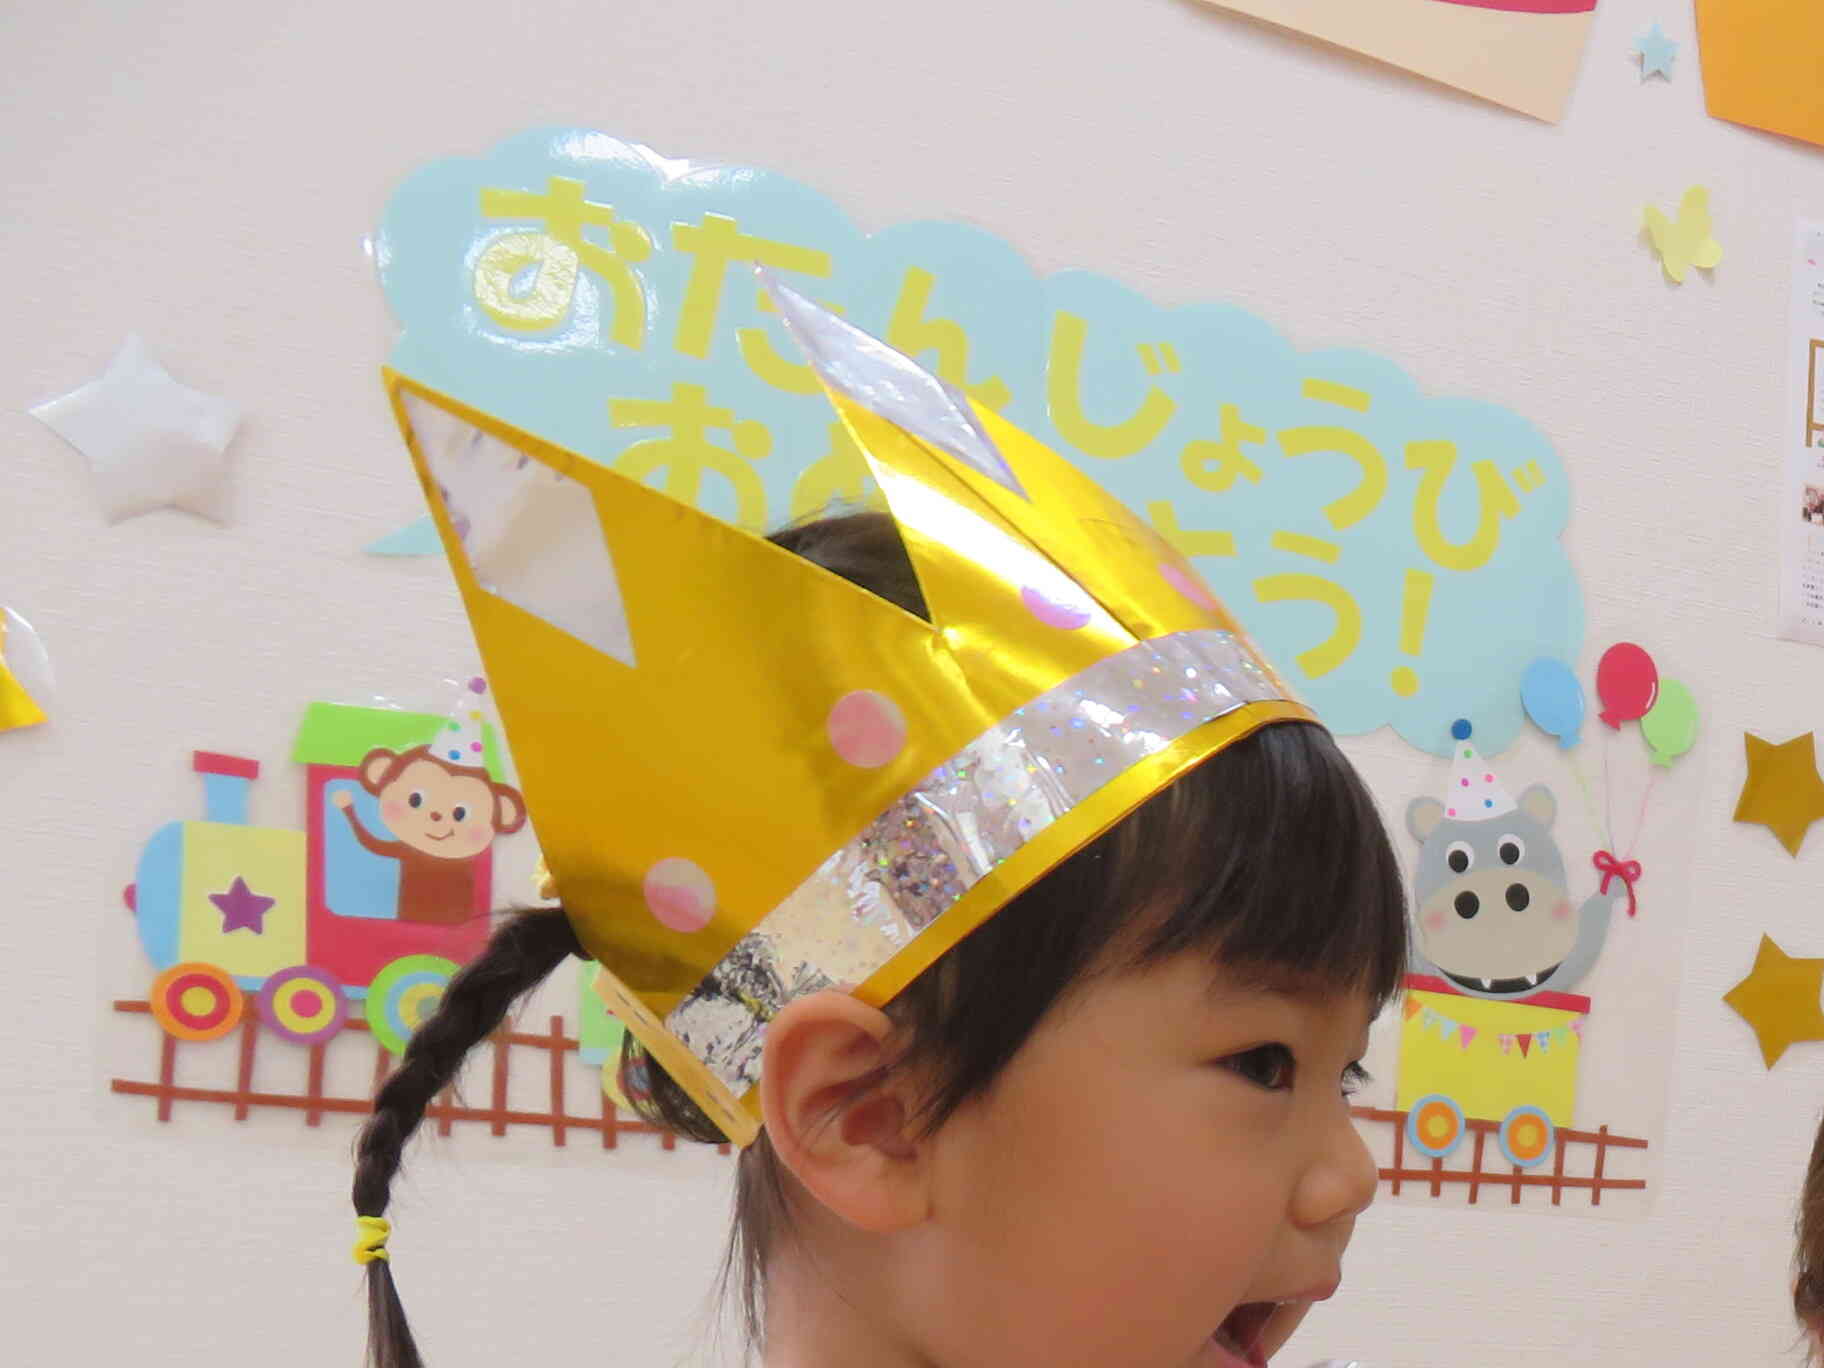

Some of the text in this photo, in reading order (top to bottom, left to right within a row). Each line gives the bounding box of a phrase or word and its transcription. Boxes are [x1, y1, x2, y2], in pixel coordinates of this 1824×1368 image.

[469, 172, 1545, 573] おたんじょうび
